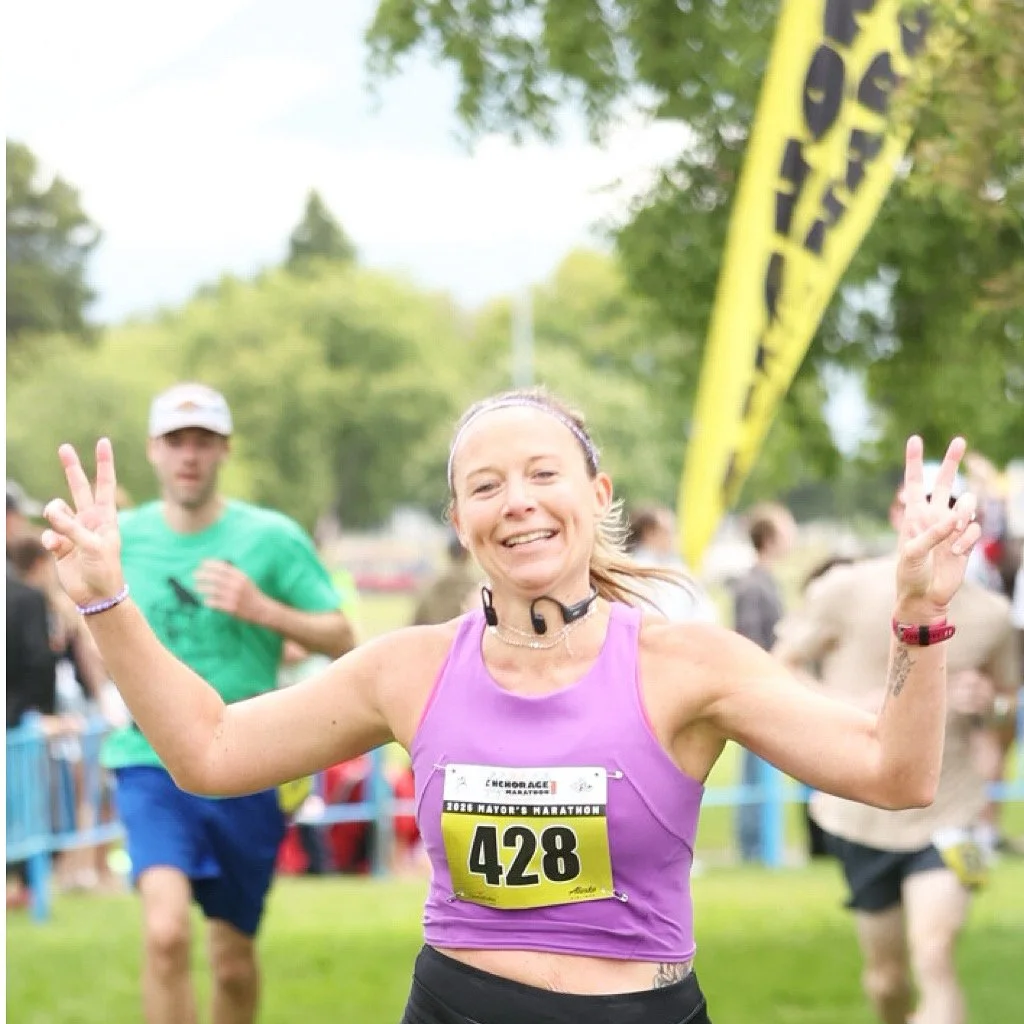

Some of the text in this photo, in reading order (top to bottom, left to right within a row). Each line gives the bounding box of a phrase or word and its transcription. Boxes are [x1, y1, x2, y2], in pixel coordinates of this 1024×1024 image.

[478, 804, 528, 815] MAYOR'S
[533, 805, 601, 816] MARATHON
[469, 825, 581, 886] 428
